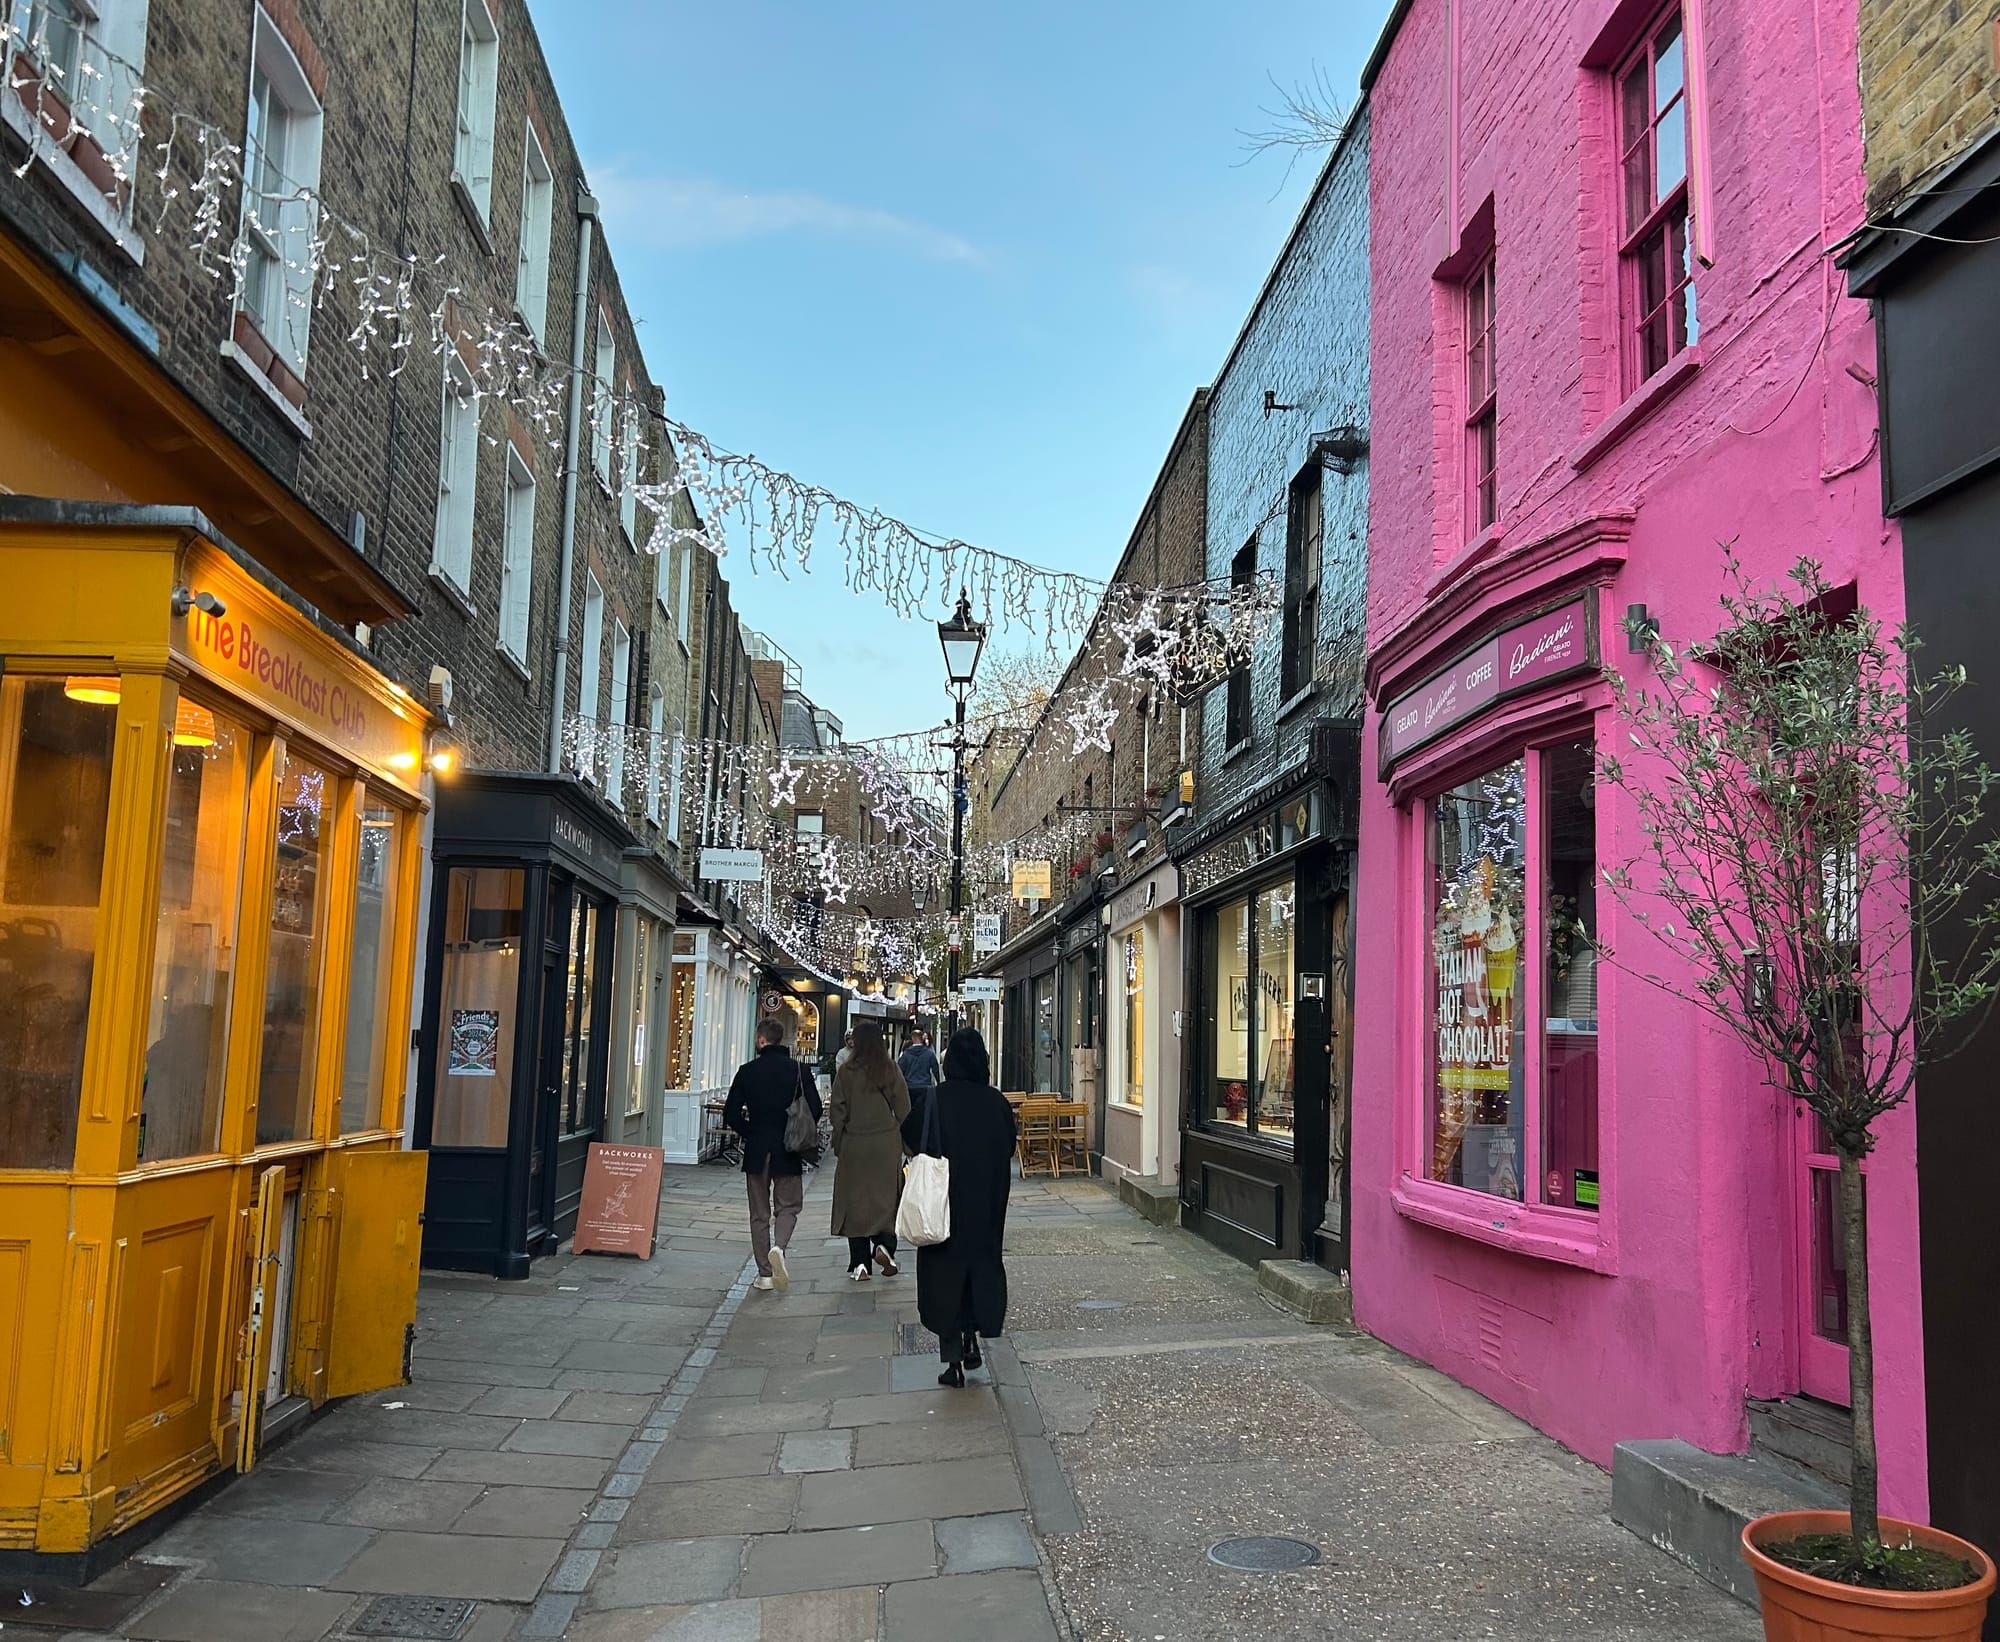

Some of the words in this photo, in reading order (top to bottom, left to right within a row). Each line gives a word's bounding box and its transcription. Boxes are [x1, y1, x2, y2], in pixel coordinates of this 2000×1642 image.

[1553, 640, 1571, 652] GELATO
[238, 622, 327, 717] Breakfast
[330, 685, 366, 740] Club
[1396, 709, 1418, 734] GELATO
[1466, 661, 1492, 691] COFFEE
[555, 814, 593, 856] BACKWORKS
[976, 928, 999, 937] BLEND
[1439, 947, 1483, 986] ITALIAN
[461, 1011, 490, 1025] Friends
[1439, 988, 1462, 1025] HOT
[1439, 1024, 1510, 1063] CHOCOLATE
[599, 1149, 653, 1160] BACKWORKS
